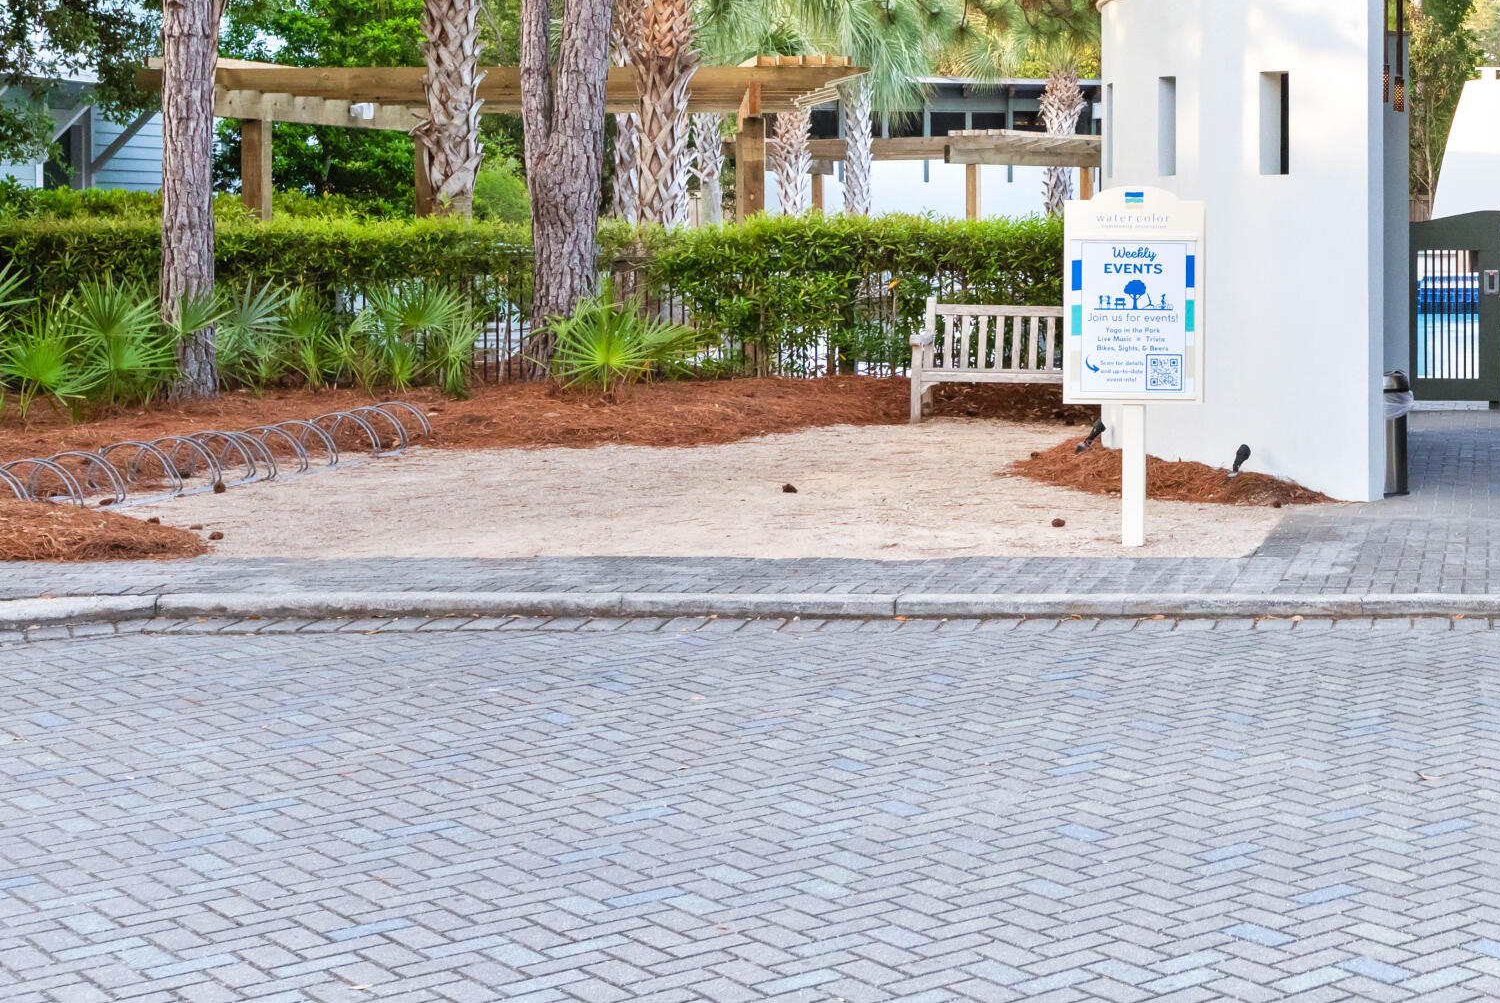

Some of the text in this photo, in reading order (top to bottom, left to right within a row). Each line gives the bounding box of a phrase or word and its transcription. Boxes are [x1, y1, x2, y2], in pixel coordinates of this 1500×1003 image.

[1112, 246, 1156, 262] Weekly
[1104, 264, 1163, 274] EVENTS
[1088, 312, 1108, 322] Join
[1126, 313, 1140, 322] for
[1144, 313, 1178, 322] events!
